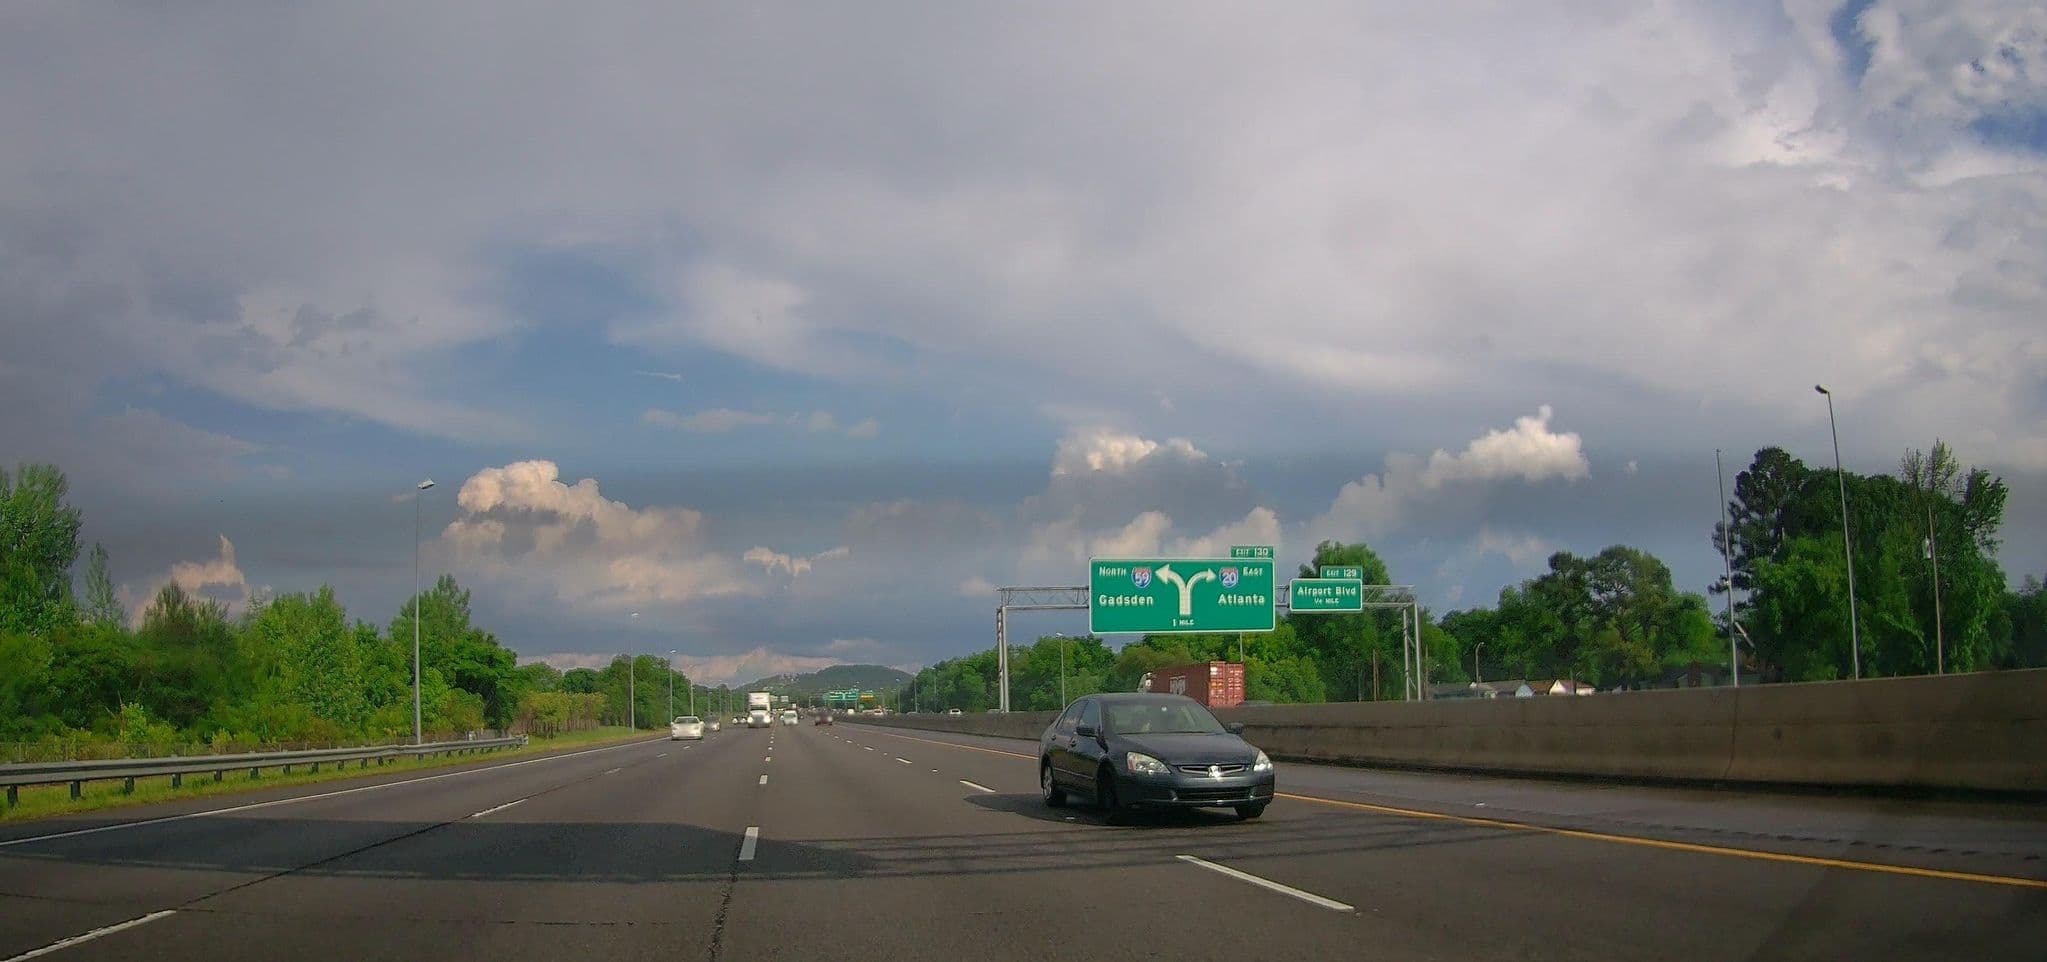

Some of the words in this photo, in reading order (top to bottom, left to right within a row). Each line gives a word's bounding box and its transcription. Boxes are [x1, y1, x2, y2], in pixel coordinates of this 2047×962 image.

[1235, 548, 1249, 556] EXIT
[1254, 547, 1269, 556] 130
[1221, 572, 1236, 582] 20
[1343, 568, 1357, 577] 129
[1134, 572, 1149, 584] 59
[1297, 586, 1332, 597] Airport
[1335, 586, 1356, 596] Blvd
[1099, 594, 1154, 607] Gadsden
[1218, 594, 1265, 606] Atlanta
[1178, 618, 1194, 626] MILE
